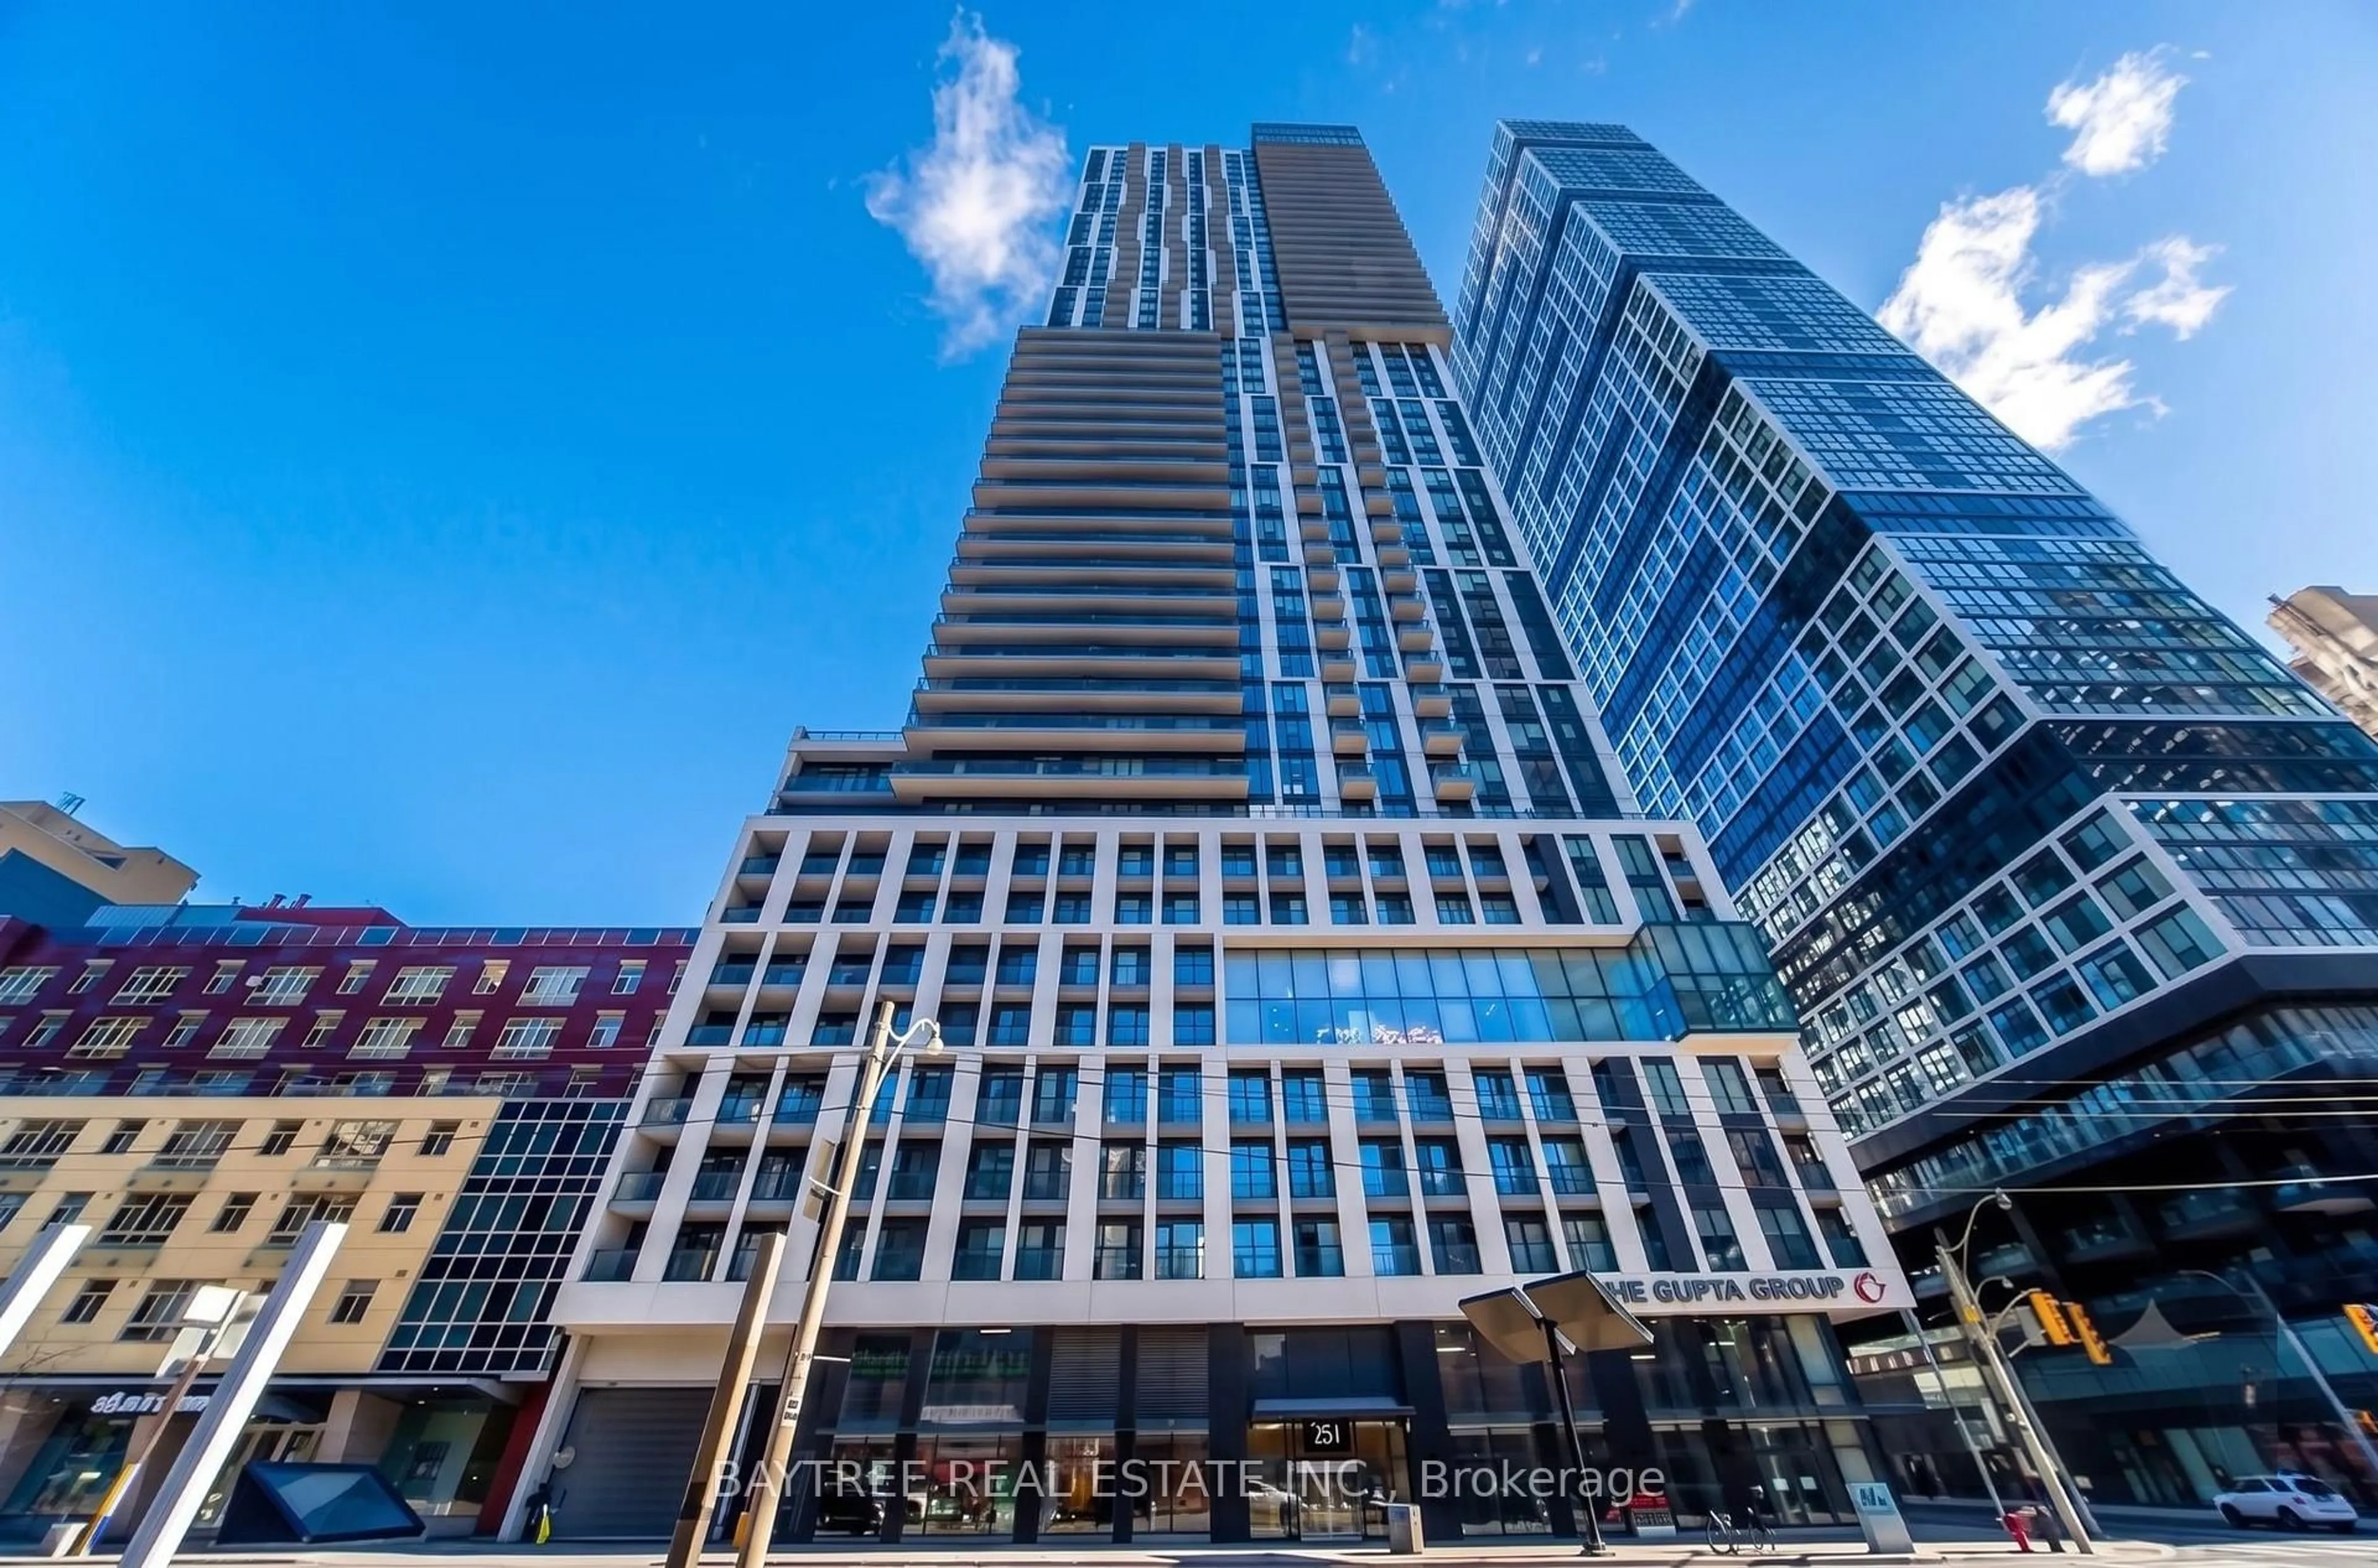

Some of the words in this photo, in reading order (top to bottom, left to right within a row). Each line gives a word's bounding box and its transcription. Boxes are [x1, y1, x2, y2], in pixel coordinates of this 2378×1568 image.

[1605, 1280, 1648, 1303] HE
[1652, 1278, 1746, 1303] GUPTA
[1749, 1276, 1845, 1300] GROUP
[1314, 1424, 1340, 1445] 251
